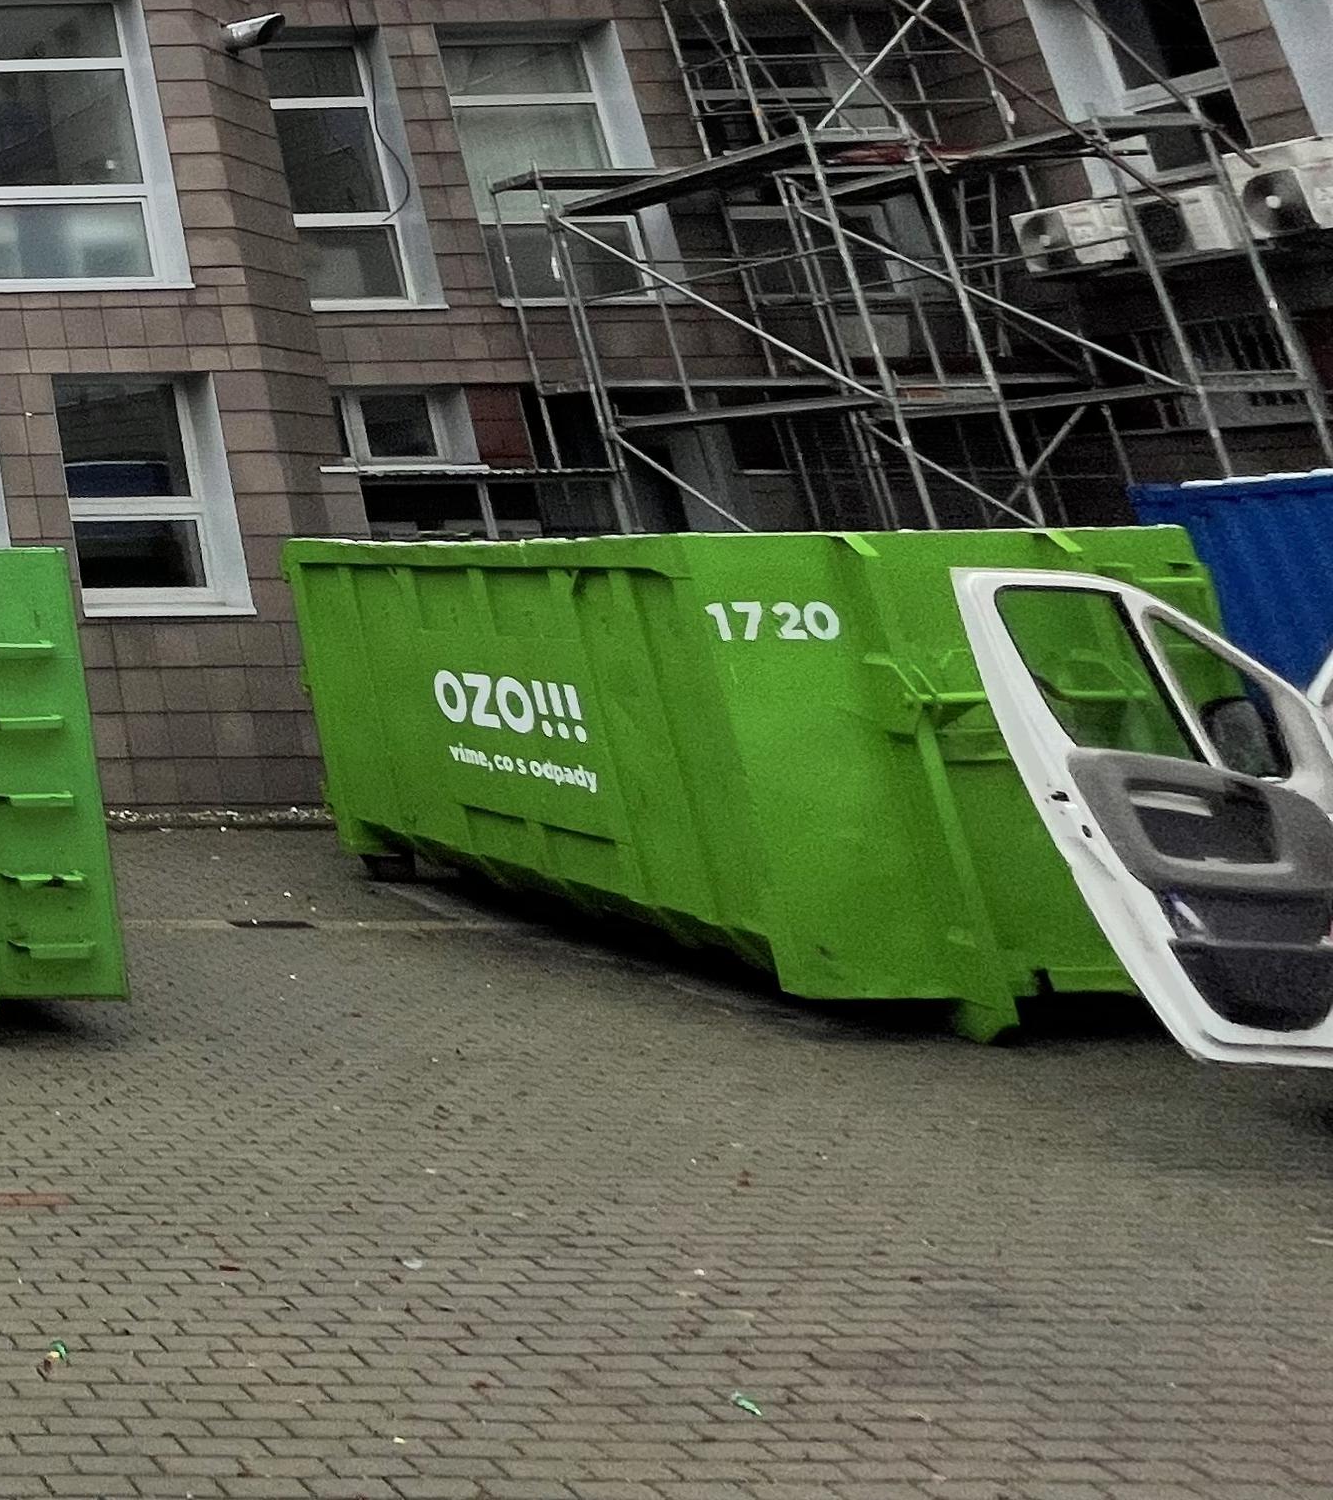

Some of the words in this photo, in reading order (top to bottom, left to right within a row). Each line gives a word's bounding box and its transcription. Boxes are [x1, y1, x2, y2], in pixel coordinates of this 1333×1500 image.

[434, 670, 587, 743] OZO!!!
[493, 754, 514, 772] co
[516, 757, 527, 775] s
[529, 759, 597, 793] odpady
